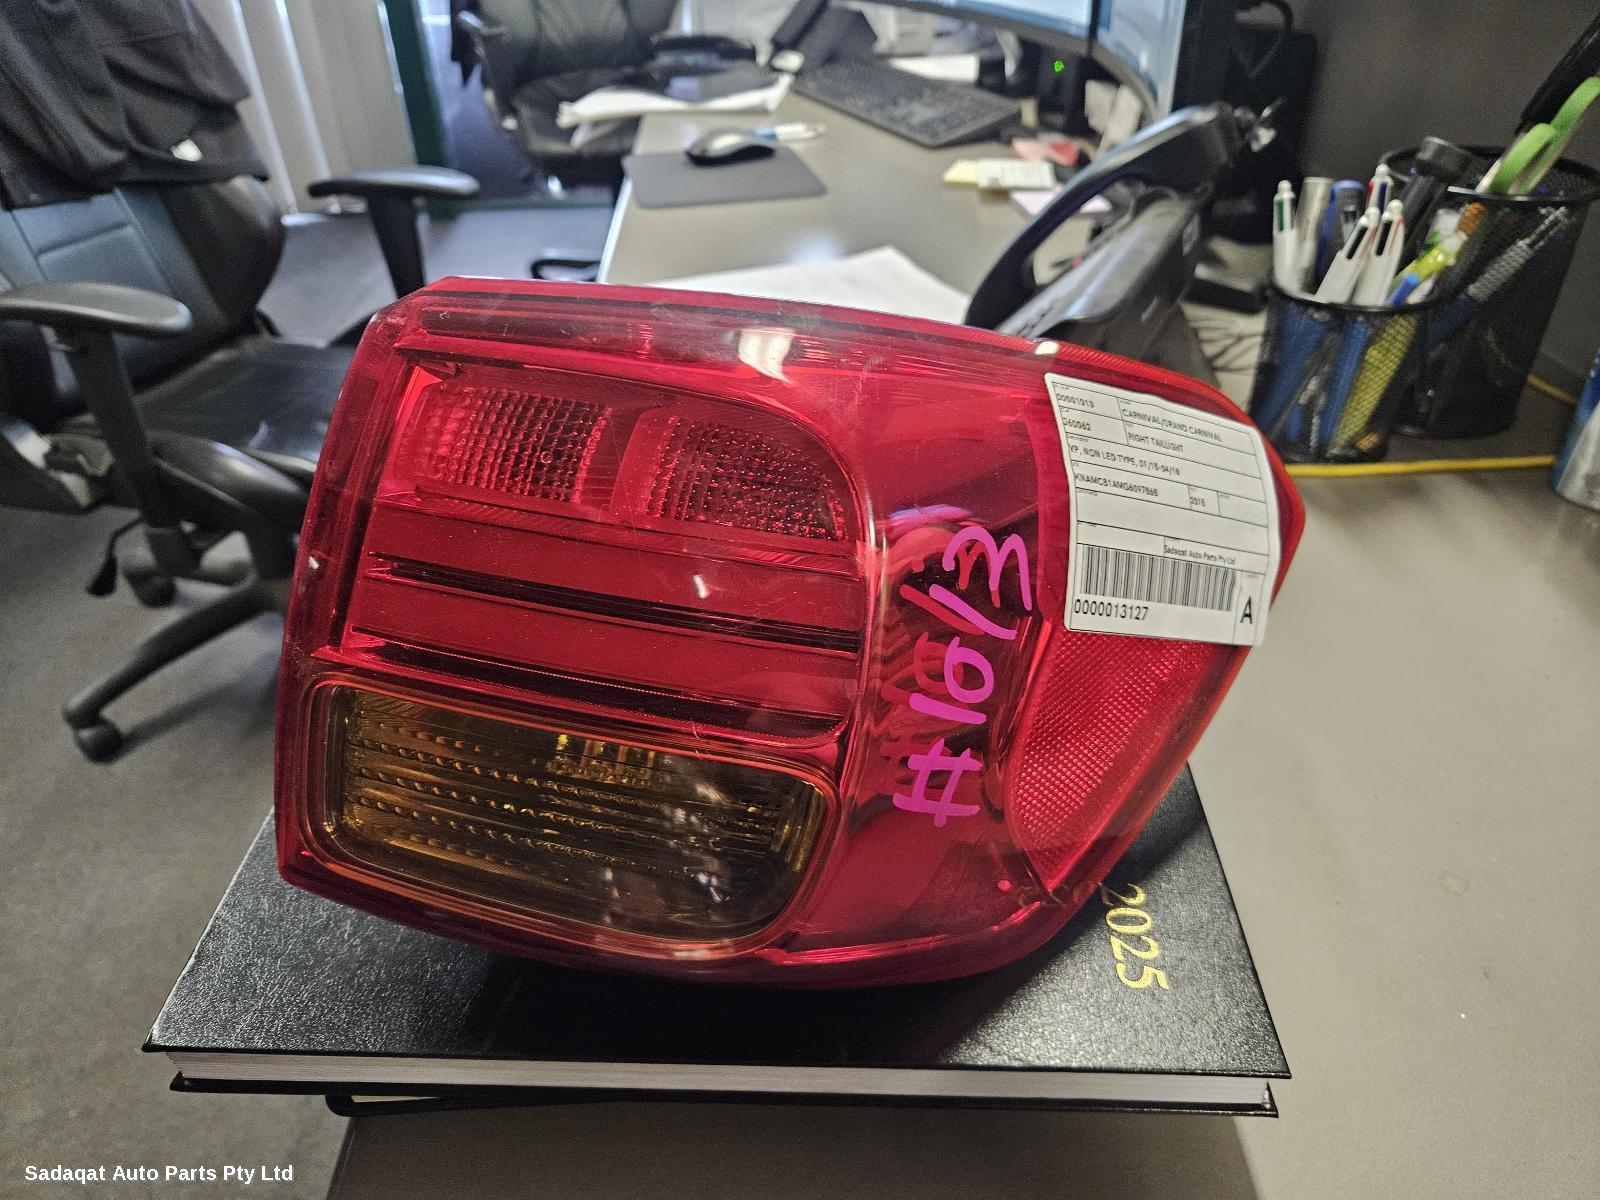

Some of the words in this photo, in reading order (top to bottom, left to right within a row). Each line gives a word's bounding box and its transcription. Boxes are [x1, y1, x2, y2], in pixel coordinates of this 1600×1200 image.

[1122, 408, 1188, 433] CARNIVAL/GRAND
[1189, 426, 1223, 443] CARNIVAL
[1127, 432, 1150, 444] RIGHT
[1150, 437, 1184, 453] TAILLIGHT
[1083, 447, 1100, 458] NON
[1102, 450, 1117, 461] LED
[1117, 455, 1138, 467] TYPE,
[1163, 544, 1187, 557] Sadaqat
[1189, 550, 1202, 559] Auto
[1203, 552, 1217, 561] Parts
[1074, 598, 1149, 621] 0000013127
[1240, 595, 1253, 624] A
[1099, 882, 1169, 991] 2025
